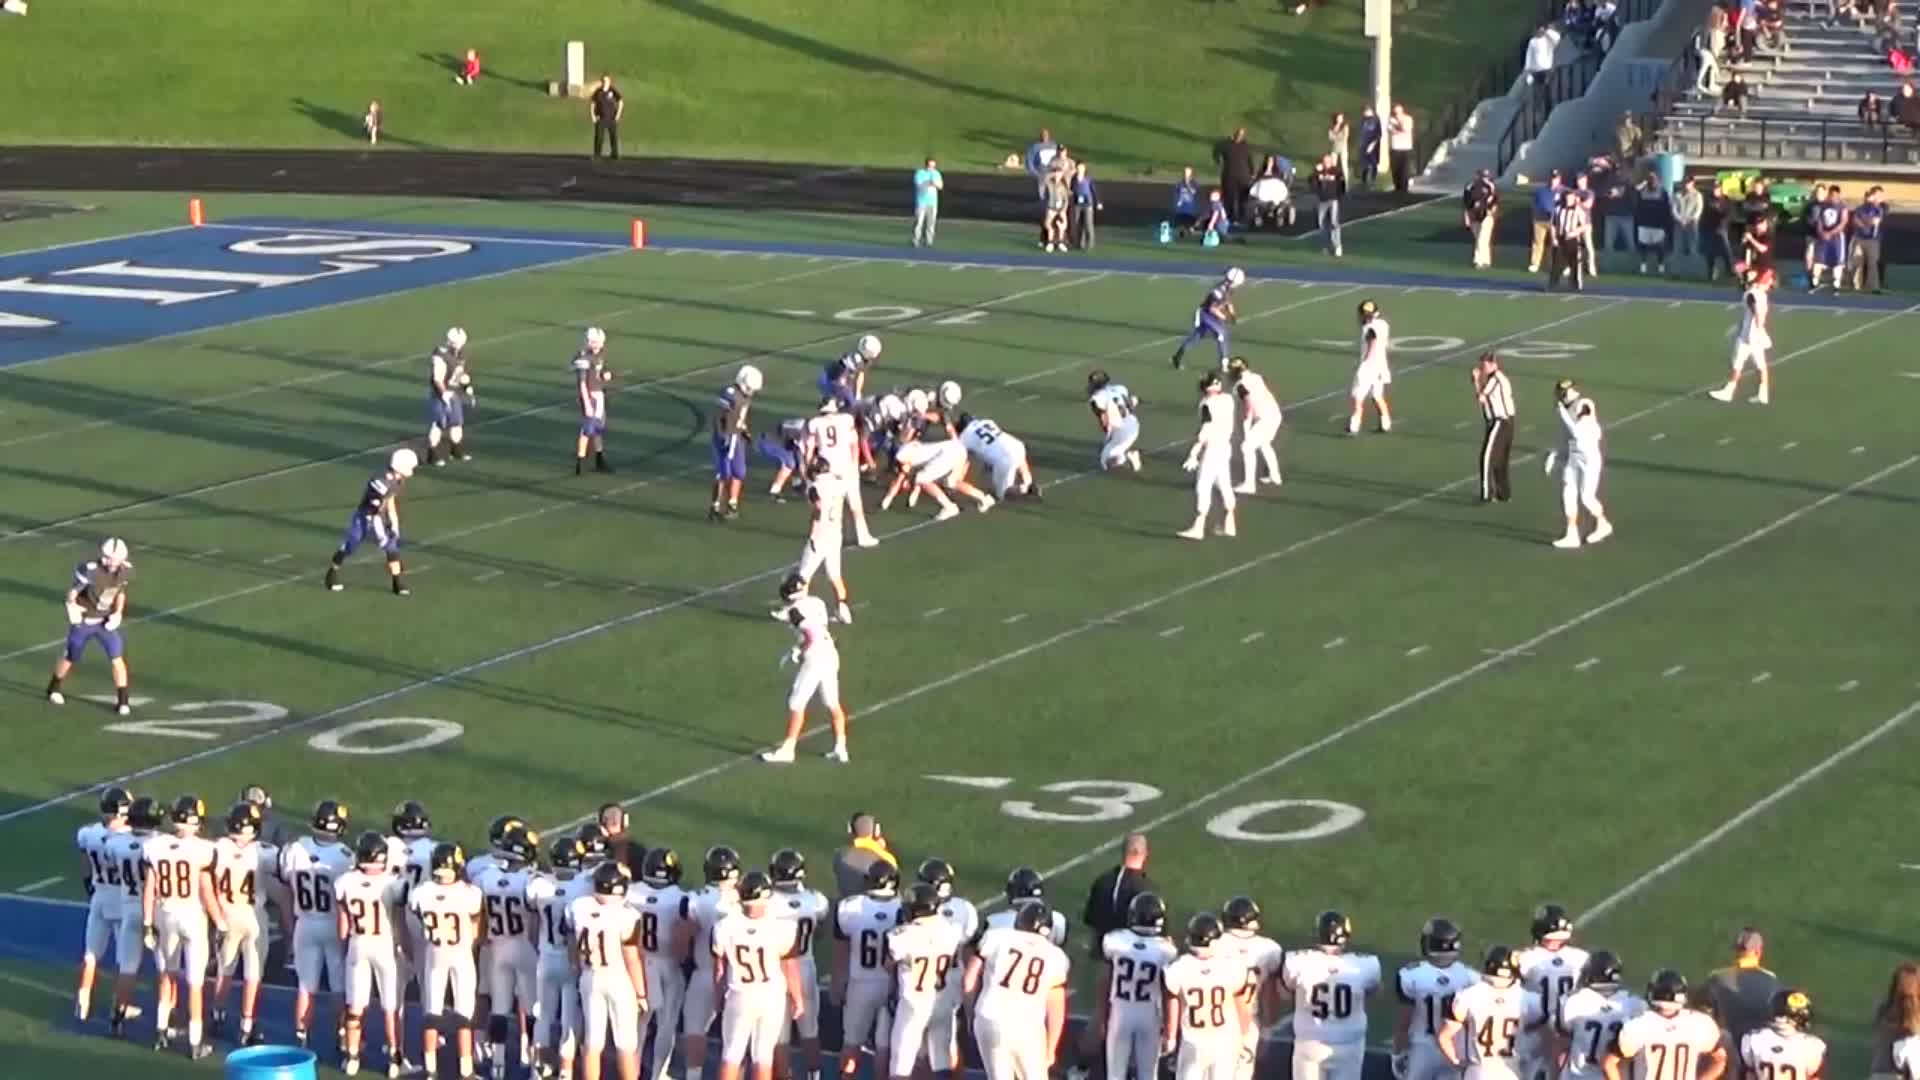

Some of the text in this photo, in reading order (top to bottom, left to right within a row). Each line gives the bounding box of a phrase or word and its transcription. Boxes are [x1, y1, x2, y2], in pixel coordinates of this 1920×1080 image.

[1001, 780, 1365, 842] 30
[157, 859, 191, 898] 88
[219, 867, 256, 905] 44
[296, 871, 331, 912] 66
[350, 898, 381, 935] 21
[423, 911, 461, 947] 23
[486, 896, 524, 936] 56
[578, 927, 609, 966] 41
[735, 945, 770, 983] 51
[860, 929, 887, 968] 6
[999, 949, 1044, 994] 78
[1116, 957, 1157, 1002] 22
[1187, 987, 1225, 1028] 28
[1651, 1043, 1690, 1080] 70
